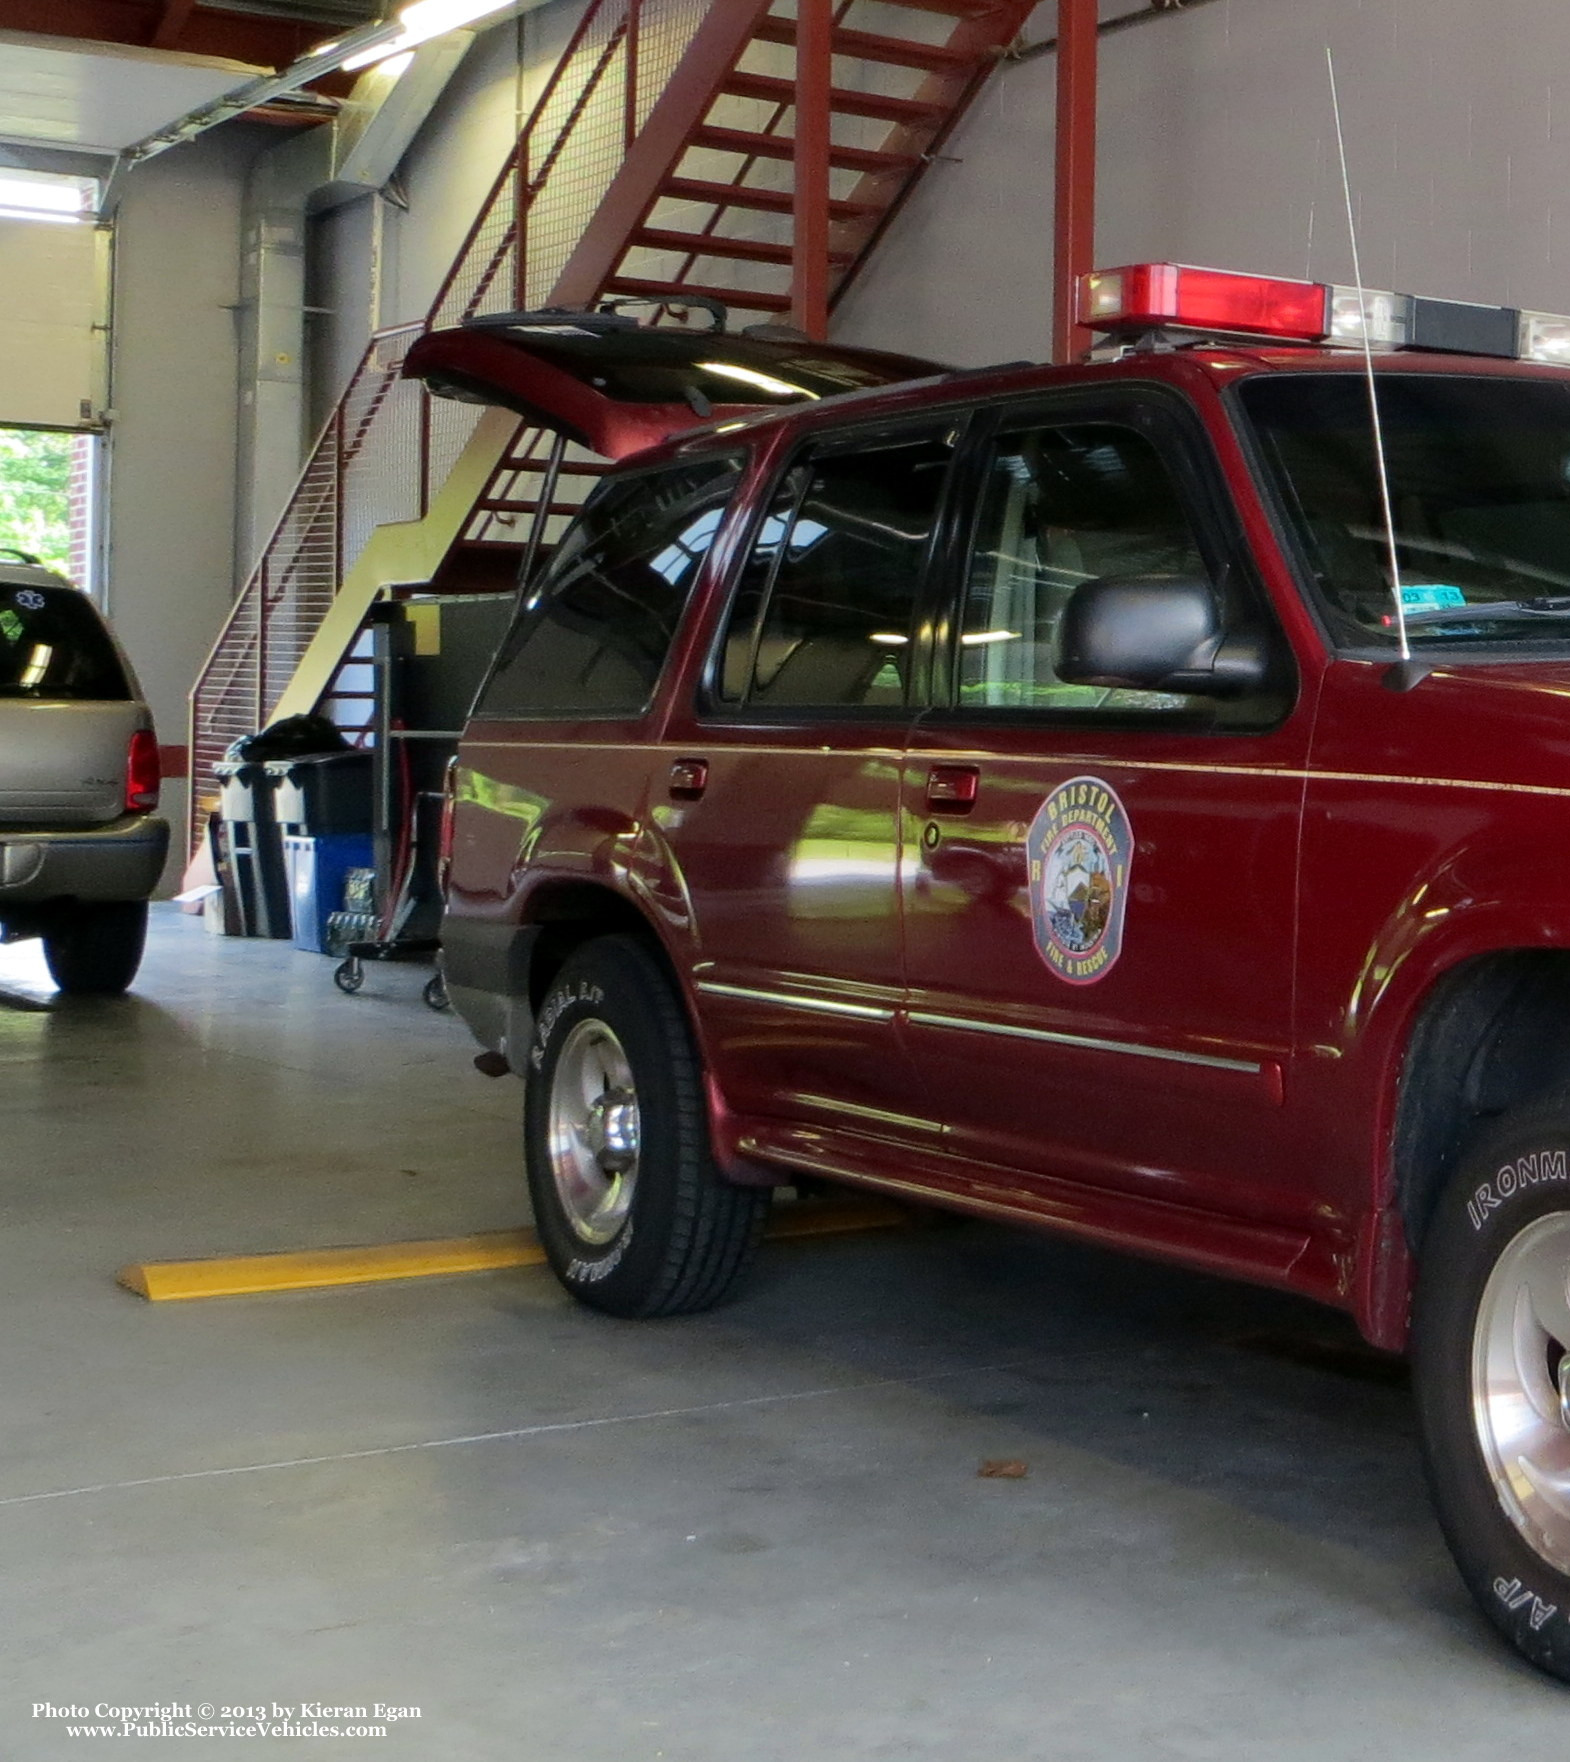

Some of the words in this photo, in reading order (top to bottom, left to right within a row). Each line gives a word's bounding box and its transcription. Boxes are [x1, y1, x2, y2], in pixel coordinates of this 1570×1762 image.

[1047, 784, 1115, 824] BRISTOL
[1040, 823, 1059, 854] FIRE
[1061, 808, 1117, 855] DEPARTMENT
[1031, 860, 1042, 882] R
[1116, 864, 1124, 887] I
[1046, 940, 1064, 968] FIRE
[1066, 959, 1073, 974] &
[1076, 945, 1108, 976] RESCUE
[1493, 1576, 1557, 1630] A/P
